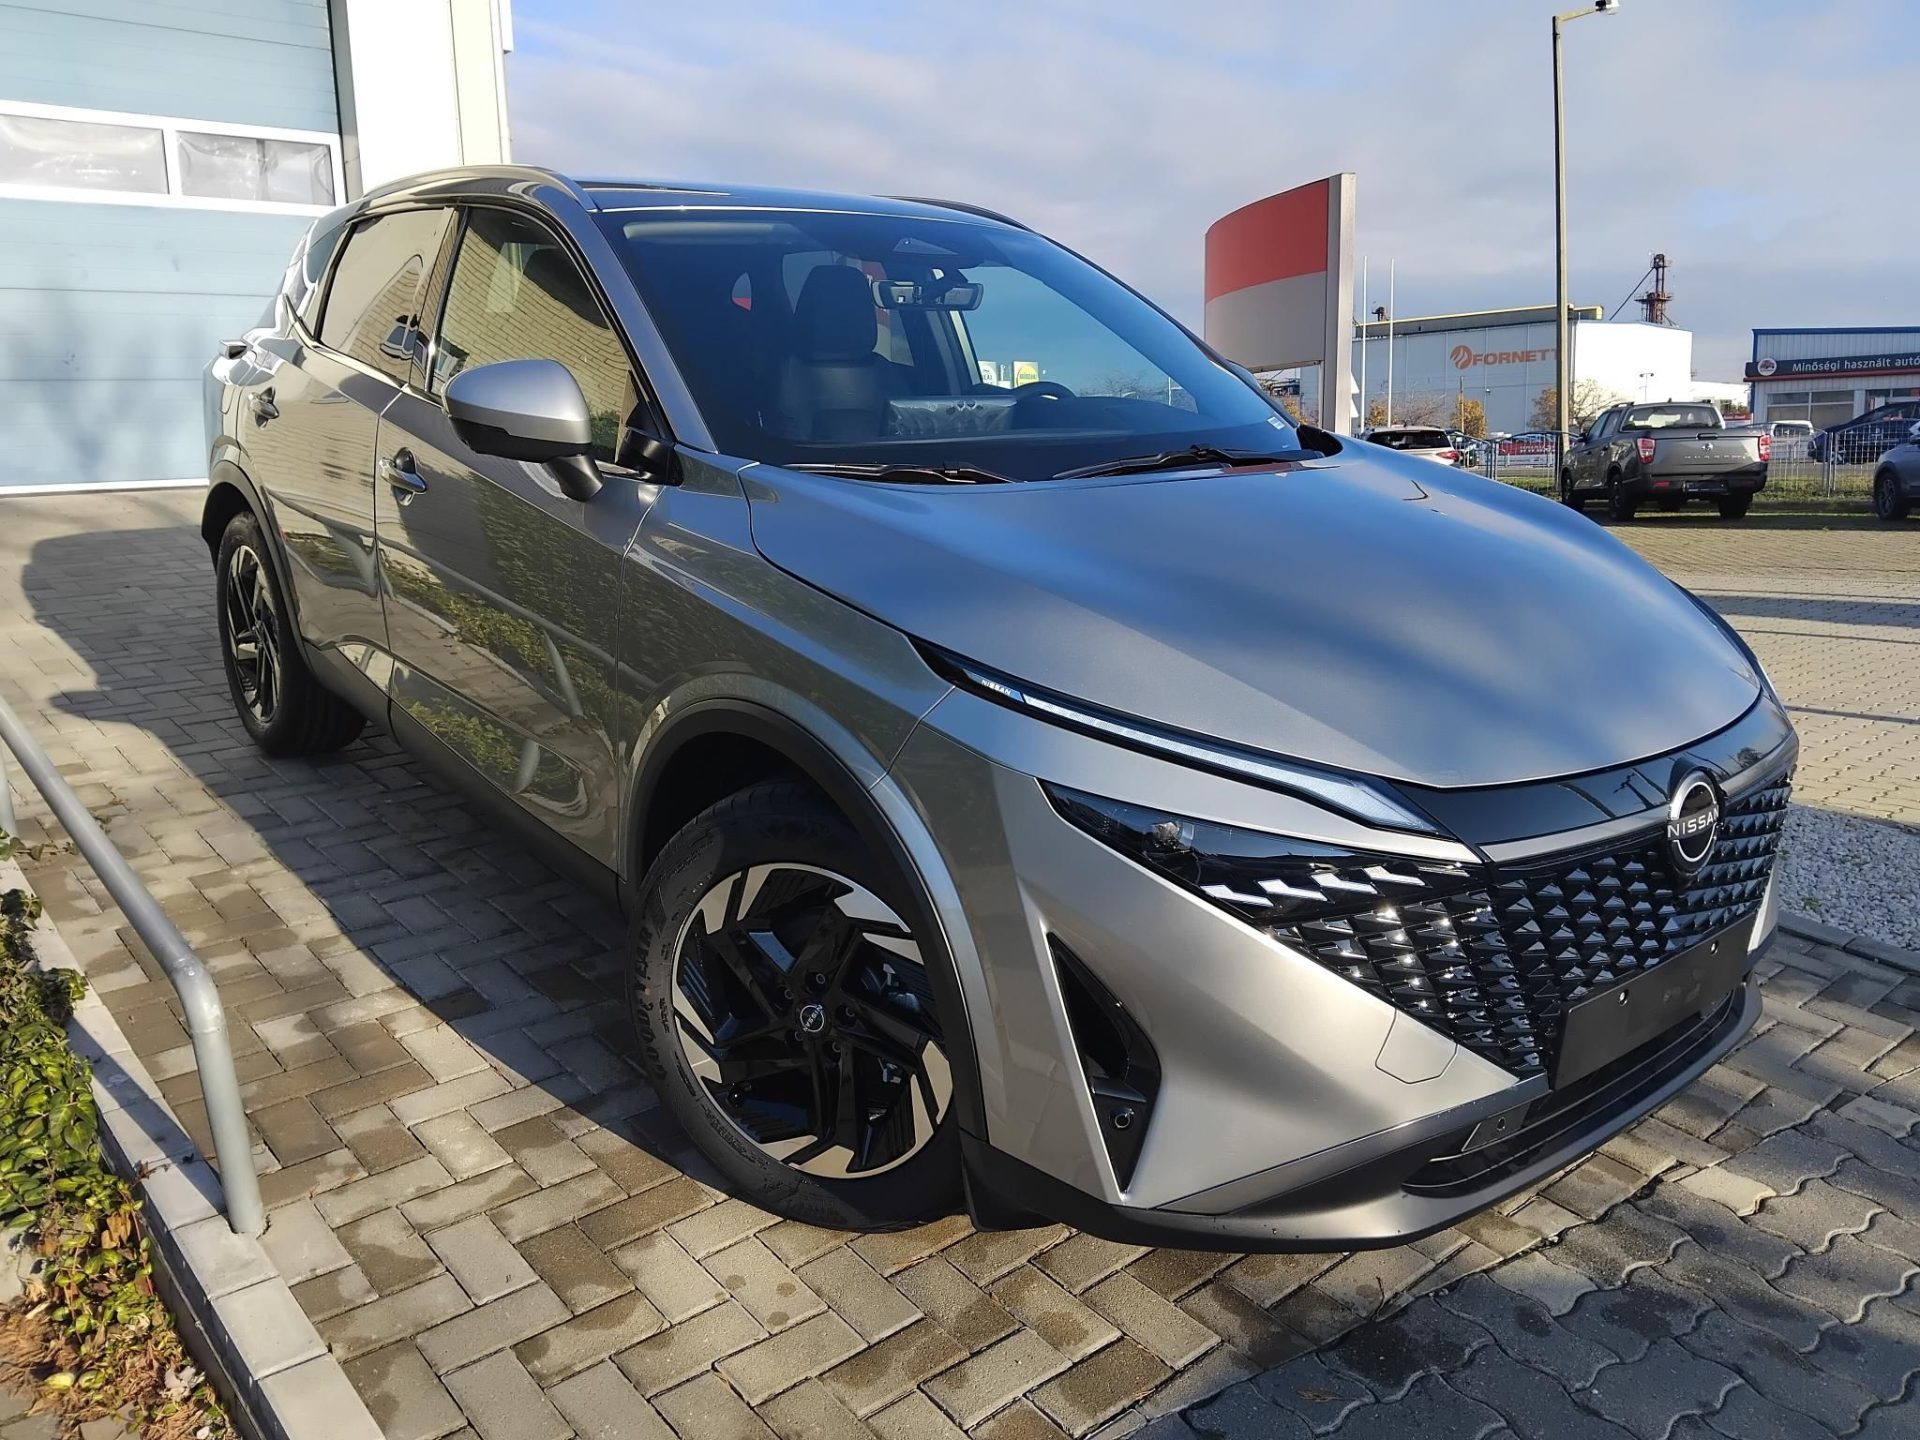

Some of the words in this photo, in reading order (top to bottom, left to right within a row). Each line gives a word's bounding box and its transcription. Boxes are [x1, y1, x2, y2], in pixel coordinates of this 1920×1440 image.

[1792, 360, 1840, 372] Minőségi
[1844, 357, 1891, 369] használt
[1667, 807, 1719, 838] NISSAN
